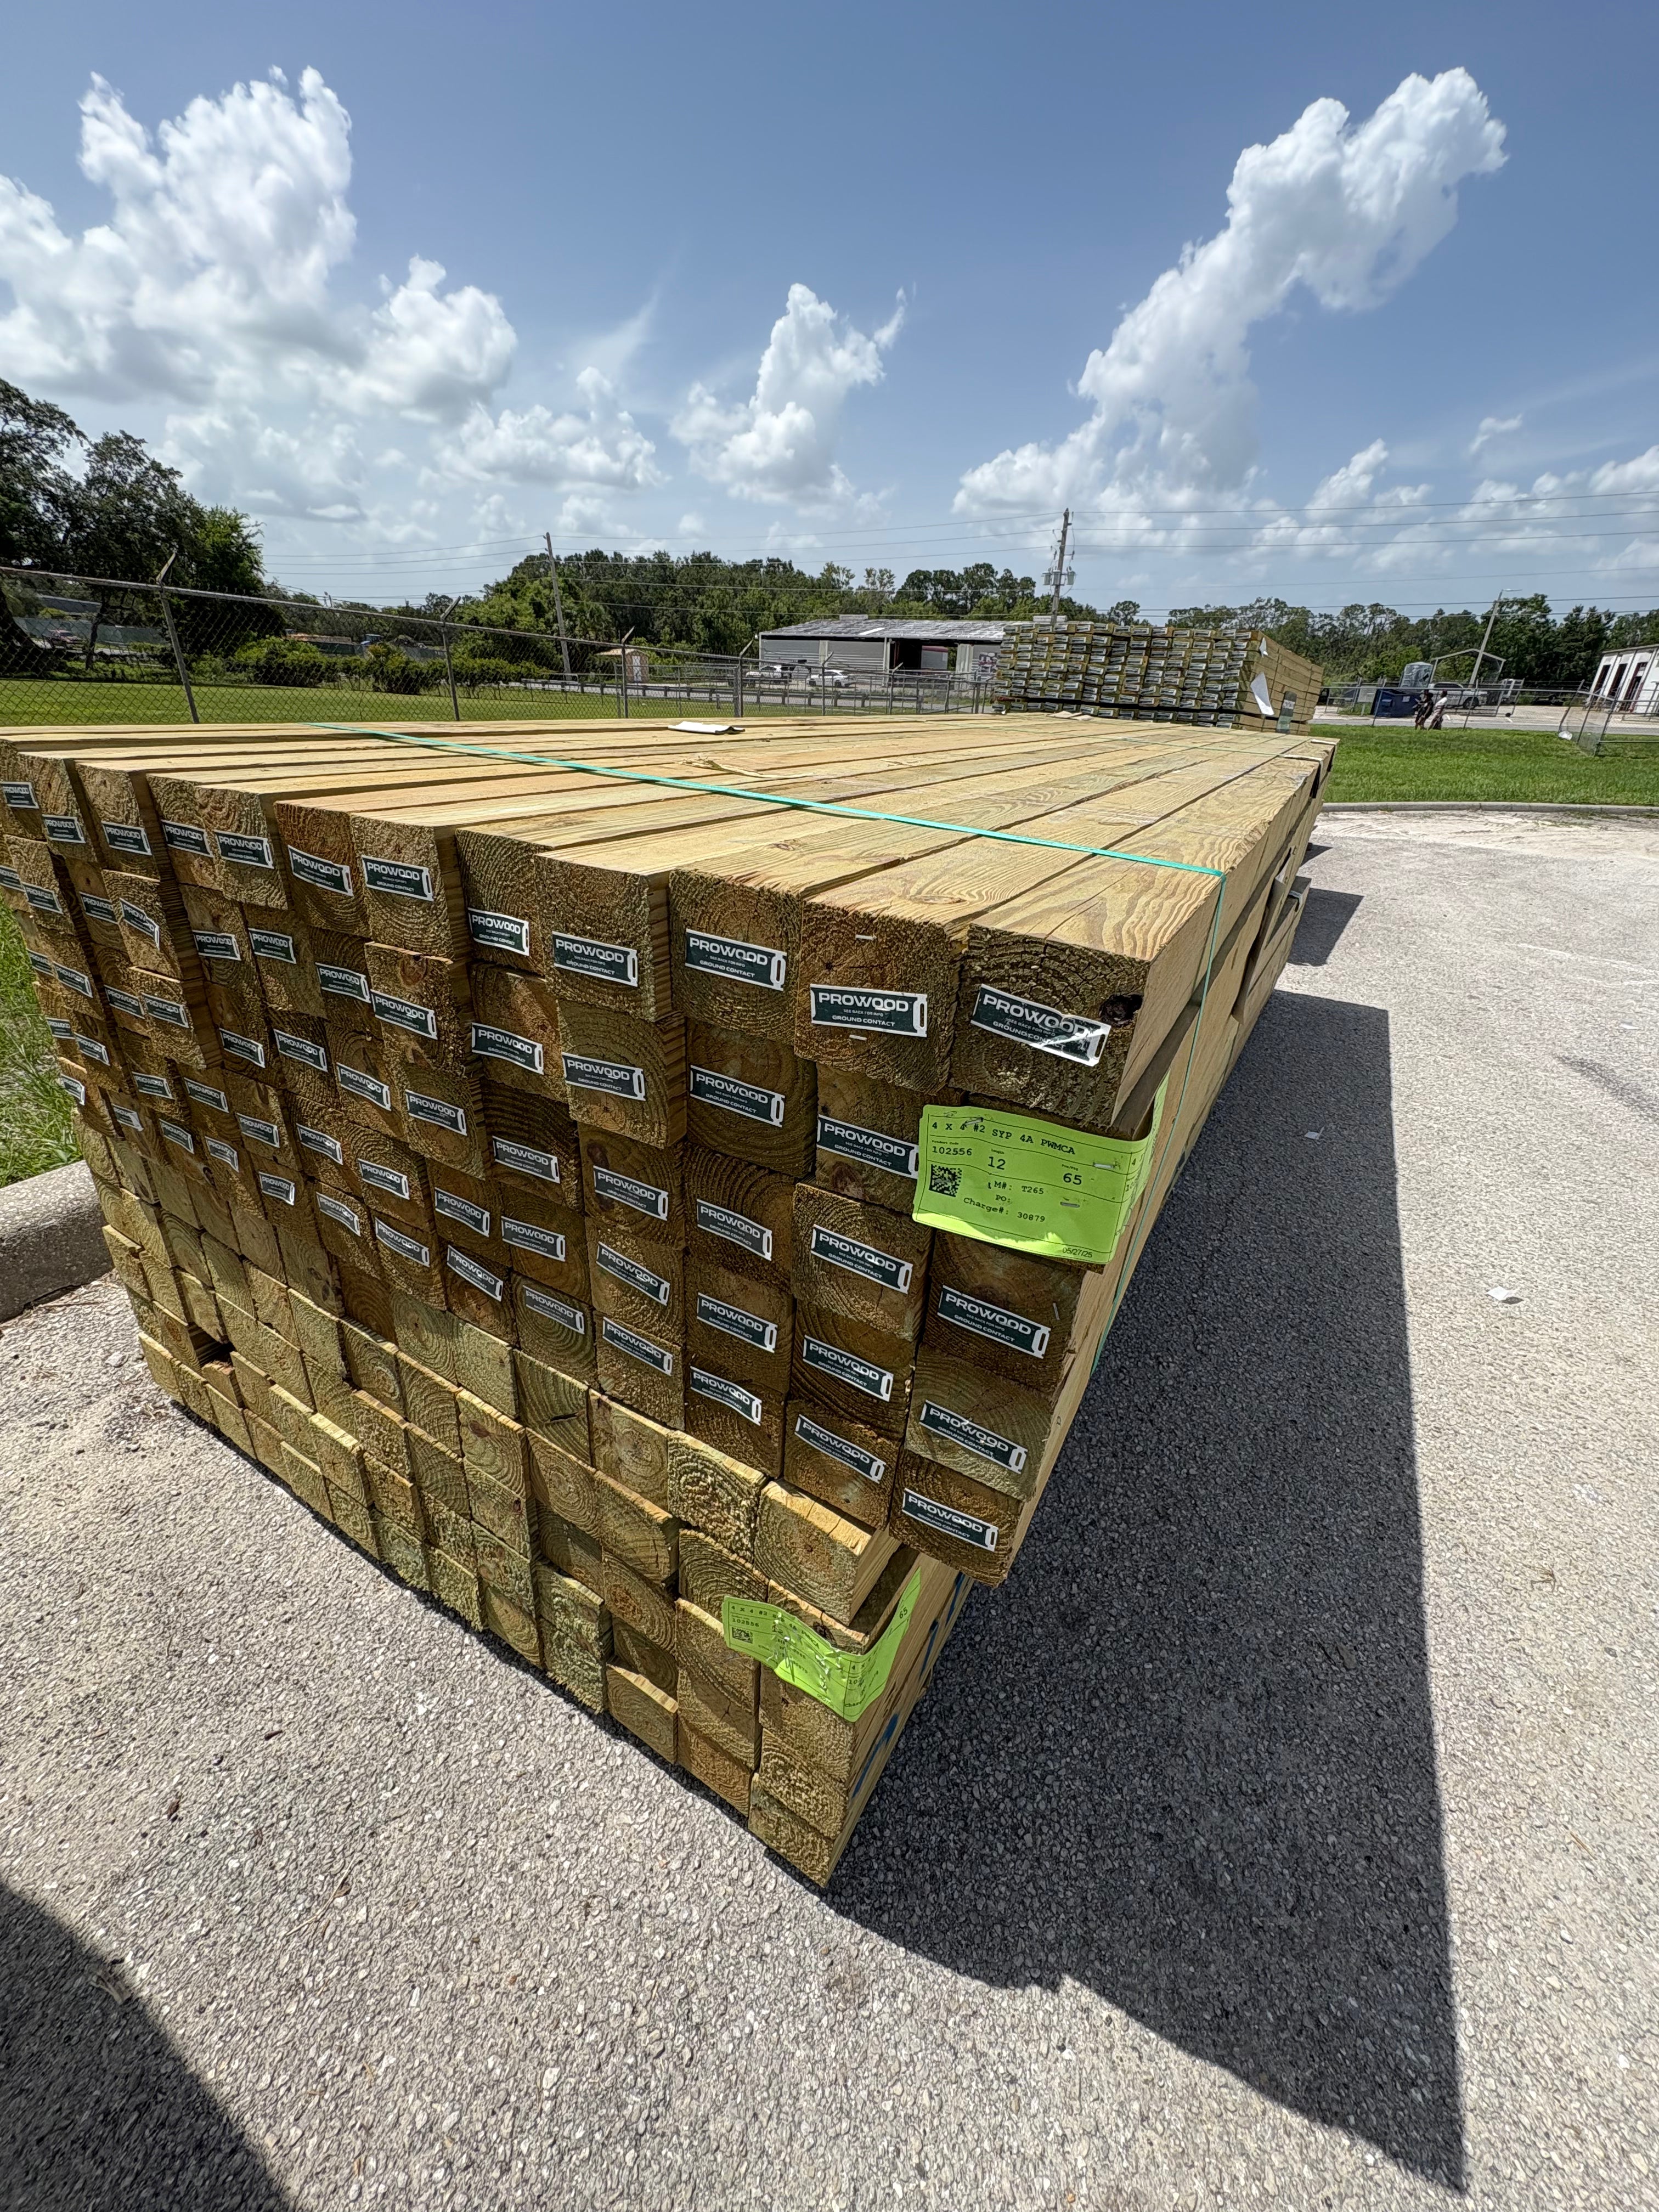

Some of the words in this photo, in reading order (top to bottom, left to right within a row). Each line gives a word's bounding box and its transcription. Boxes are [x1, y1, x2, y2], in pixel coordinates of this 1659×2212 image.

[165, 826, 203, 841] PROWOOD
[219, 836, 262, 850] PROWOOD
[292, 852, 341, 877] PROWOOD
[367, 862, 420, 881] PROWOOD
[472, 915, 521, 934] PROWOOD
[195, 934, 232, 946] PROWOOD
[252, 934, 288, 947] PROWOOD
[555, 939, 624, 963] PROWOOD
[690, 937, 768, 966] PROWOOD
[320, 968, 360, 985] PROWOOD
[566, 960, 588, 969] GROUND
[589, 964, 615, 975] CONTACT
[699, 960, 726, 970] GROUND
[726, 966, 755, 978] CONTACT
[375, 996, 425, 1020] PROWOOD
[819, 992, 909, 1013] PROWOOD
[862, 1018, 895, 1027] CONTACT
[983, 994, 1088, 1037] PROWOOD
[1018, 1022, 1031, 1030] BACK
[993, 1021, 1026, 1036] GROUND
[478, 1030, 533, 1054] PROWOOD
[341, 1069, 381, 1093] PROWOOD
[567, 1060, 630, 1081] PROWOOD
[578, 1077, 599, 1086] GROUND
[600, 1081, 622, 1091] CONTACT
[696, 1074, 768, 1103] PROWOOD
[410, 1096, 455, 1118] PROWOOD
[706, 1093, 730, 1104] GROUND
[730, 1102, 757, 1114] CONTACT
[824, 1124, 906, 1156] PROWOOD
[973, 1124, 985, 1133] #2
[992, 1129, 1012, 1139] SYP
[1020, 1135, 1034, 1143] 4A
[1041, 1138, 1075, 1155] PWMCA
[496, 1142, 549, 1166] PROWOOD
[834, 1144, 861, 1156] GROUND
[861, 1152, 891, 1166] CONTACT
[932, 1146, 972, 1156] 102556
[988, 1156, 1006, 1170] 12
[1063, 1173, 1082, 1185] 65
[362, 1163, 400, 1183] PROWOOD
[598, 1172, 656, 1201] PROWOOD
[996, 1194, 1011, 1203] PO:
[1022, 1186, 1044, 1194] T265
[438, 1193, 482, 1219] PROWOOD
[626, 1197, 647, 1208] CONTACT
[963, 1197, 1009, 1215] Charge#:
[1017, 1212, 1045, 1222] 30879
[505, 1223, 555, 1244] PROWOOD
[701, 1206, 760, 1239] PROWOOD
[379, 1224, 420, 1252] PROWOOD
[709, 1224, 730, 1235] GROUND
[730, 1233, 752, 1246] CONTACT
[820, 1232, 896, 1273] PROWOOD
[1062, 1247, 1093, 1258] 05/27/25
[451, 1251, 494, 1285] PROWOOD
[601, 1248, 658, 1288] PROWOOD
[828, 1252, 853, 1266] GROUND
[854, 1263, 883, 1279] CONTACT
[627, 1275, 648, 1290] CONTACT
[526, 1290, 574, 1319] PROWOOD
[701, 1299, 763, 1332] PROWOOD
[945, 1294, 1031, 1336] PROWOOD
[709, 1317, 730, 1328] GROUND
[730, 1326, 752, 1339] CONTACT
[955, 1314, 983, 1330] GROUND
[983, 1327, 1014, 1342] CONTACT
[607, 1324, 662, 1359] PROWOOD
[809, 1342, 879, 1381] PROWOOD
[818, 1361, 840, 1374] GROUND
[842, 1372, 867, 1386] CONTACT
[693, 1372, 750, 1406] PROWOOD
[929, 1406, 1008, 1452] PROWOOD
[802, 1421, 870, 1464] PROWOOD
[810, 1438, 832, 1454] GROUND
[832, 1451, 857, 1465] CONTACT
[938, 1426, 964, 1442] GROUND
[965, 1439, 994, 1458] CONTACT
[908, 1496, 983, 1533] PROWOOD
[917, 1513, 941, 1526] GROUND
[942, 1524, 969, 1538] CONTACT
[899, 1607, 908, 1619] 65
